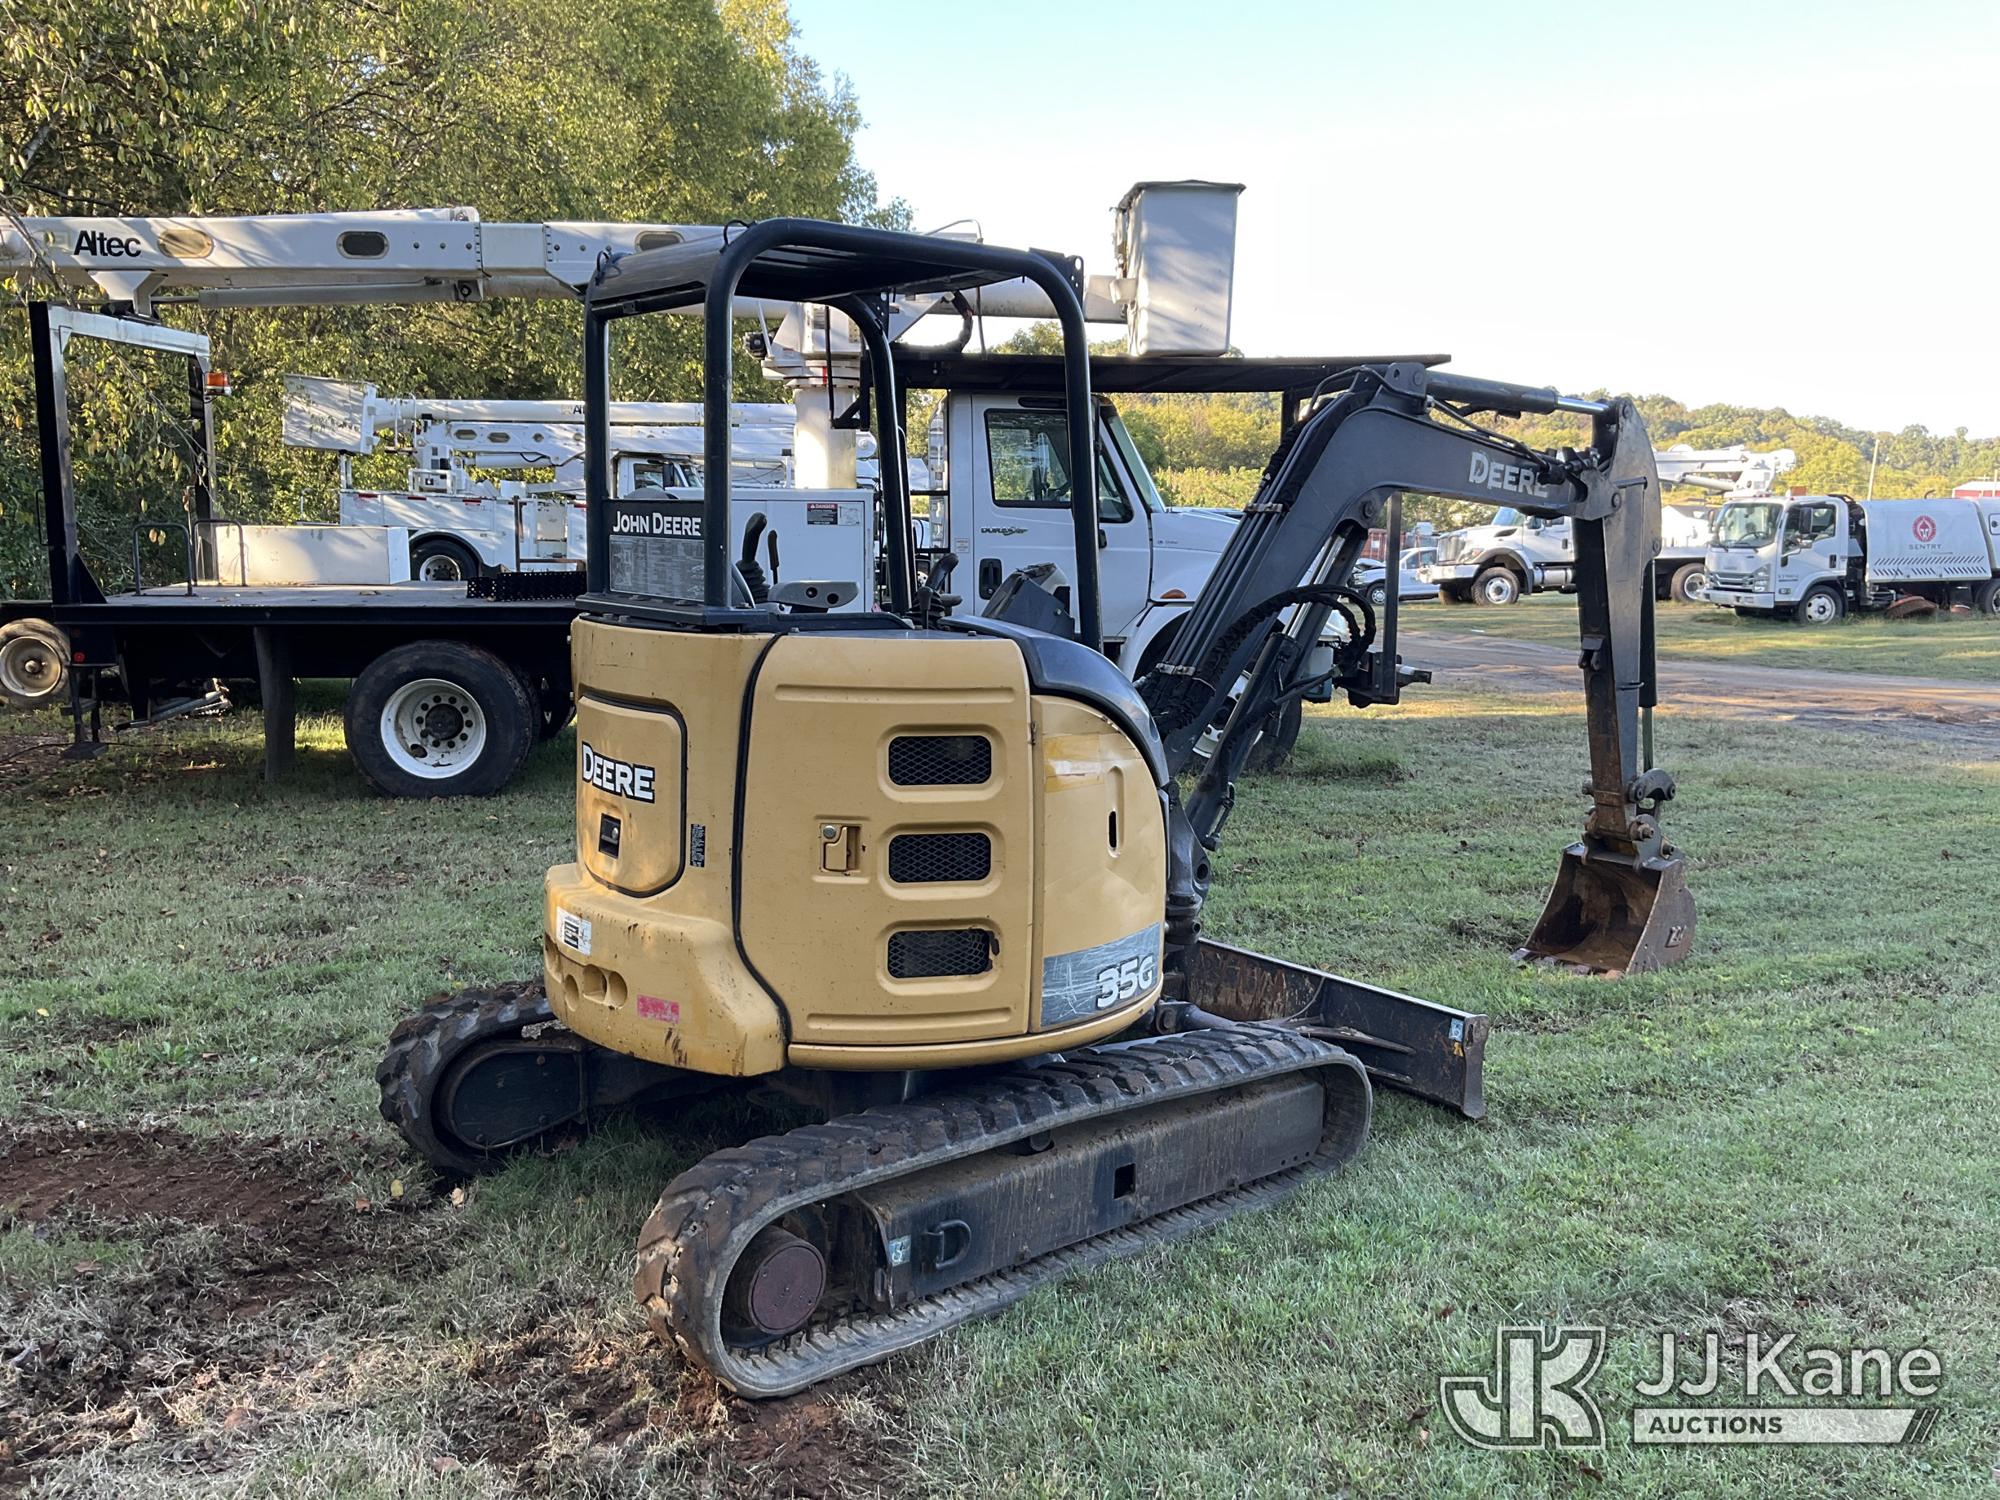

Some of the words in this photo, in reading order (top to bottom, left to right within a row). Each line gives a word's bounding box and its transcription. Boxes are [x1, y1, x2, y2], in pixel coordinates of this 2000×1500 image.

[74, 230, 141, 257] Altec
[613, 510, 649, 534] JOHN
[652, 512, 702, 537] DEERE
[582, 740, 655, 804] DEERE
[1096, 953, 1155, 1010] 35G
